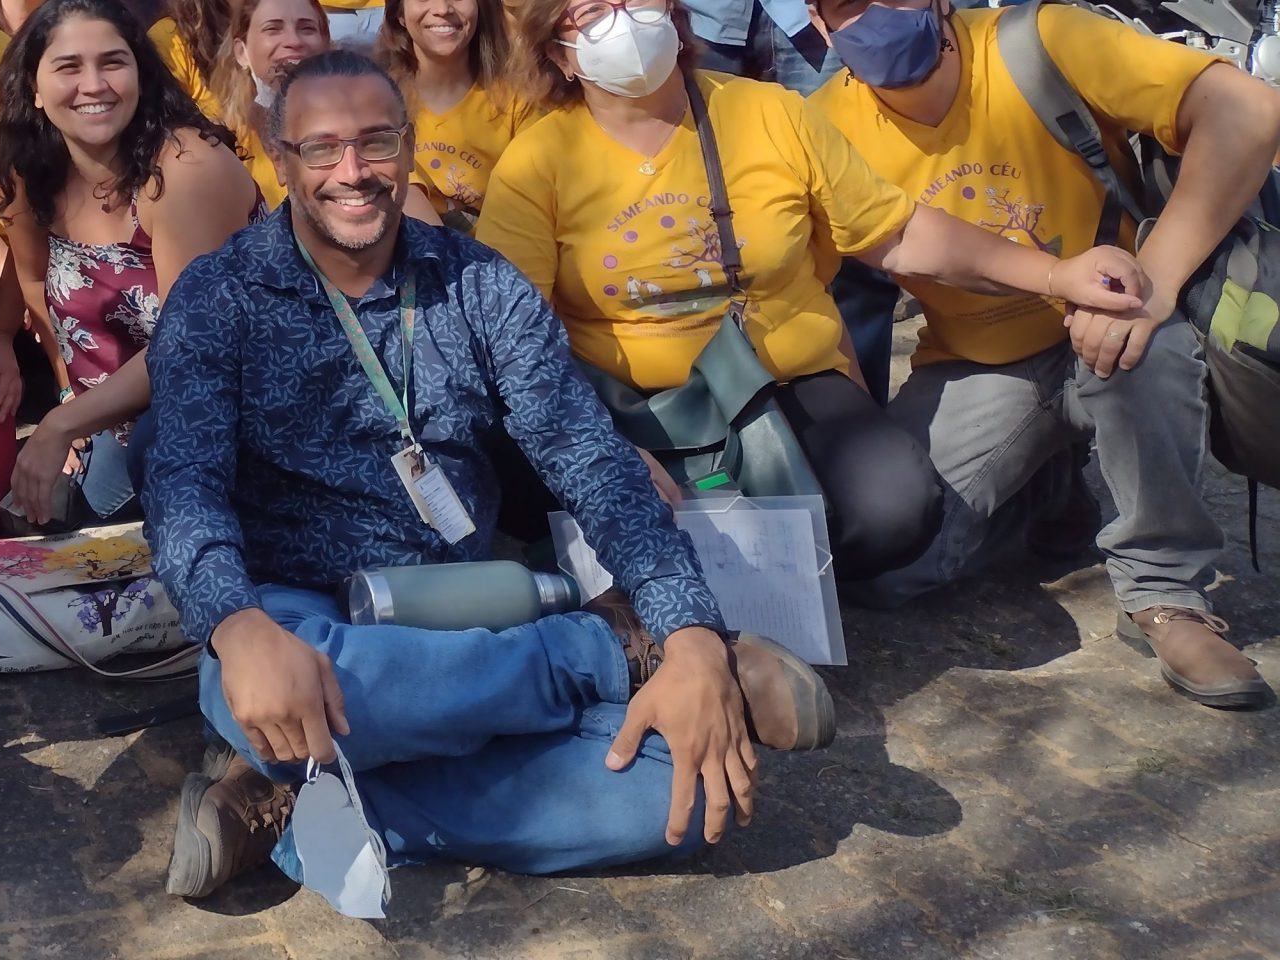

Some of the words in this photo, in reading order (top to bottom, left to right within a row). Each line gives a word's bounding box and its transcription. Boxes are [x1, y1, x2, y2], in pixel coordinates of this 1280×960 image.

[459, 151, 483, 170] CÉU
[919, 162, 983, 205] EMEANDO
[989, 161, 1022, 180] CÉU
[607, 192, 690, 233] SEMEANDO
